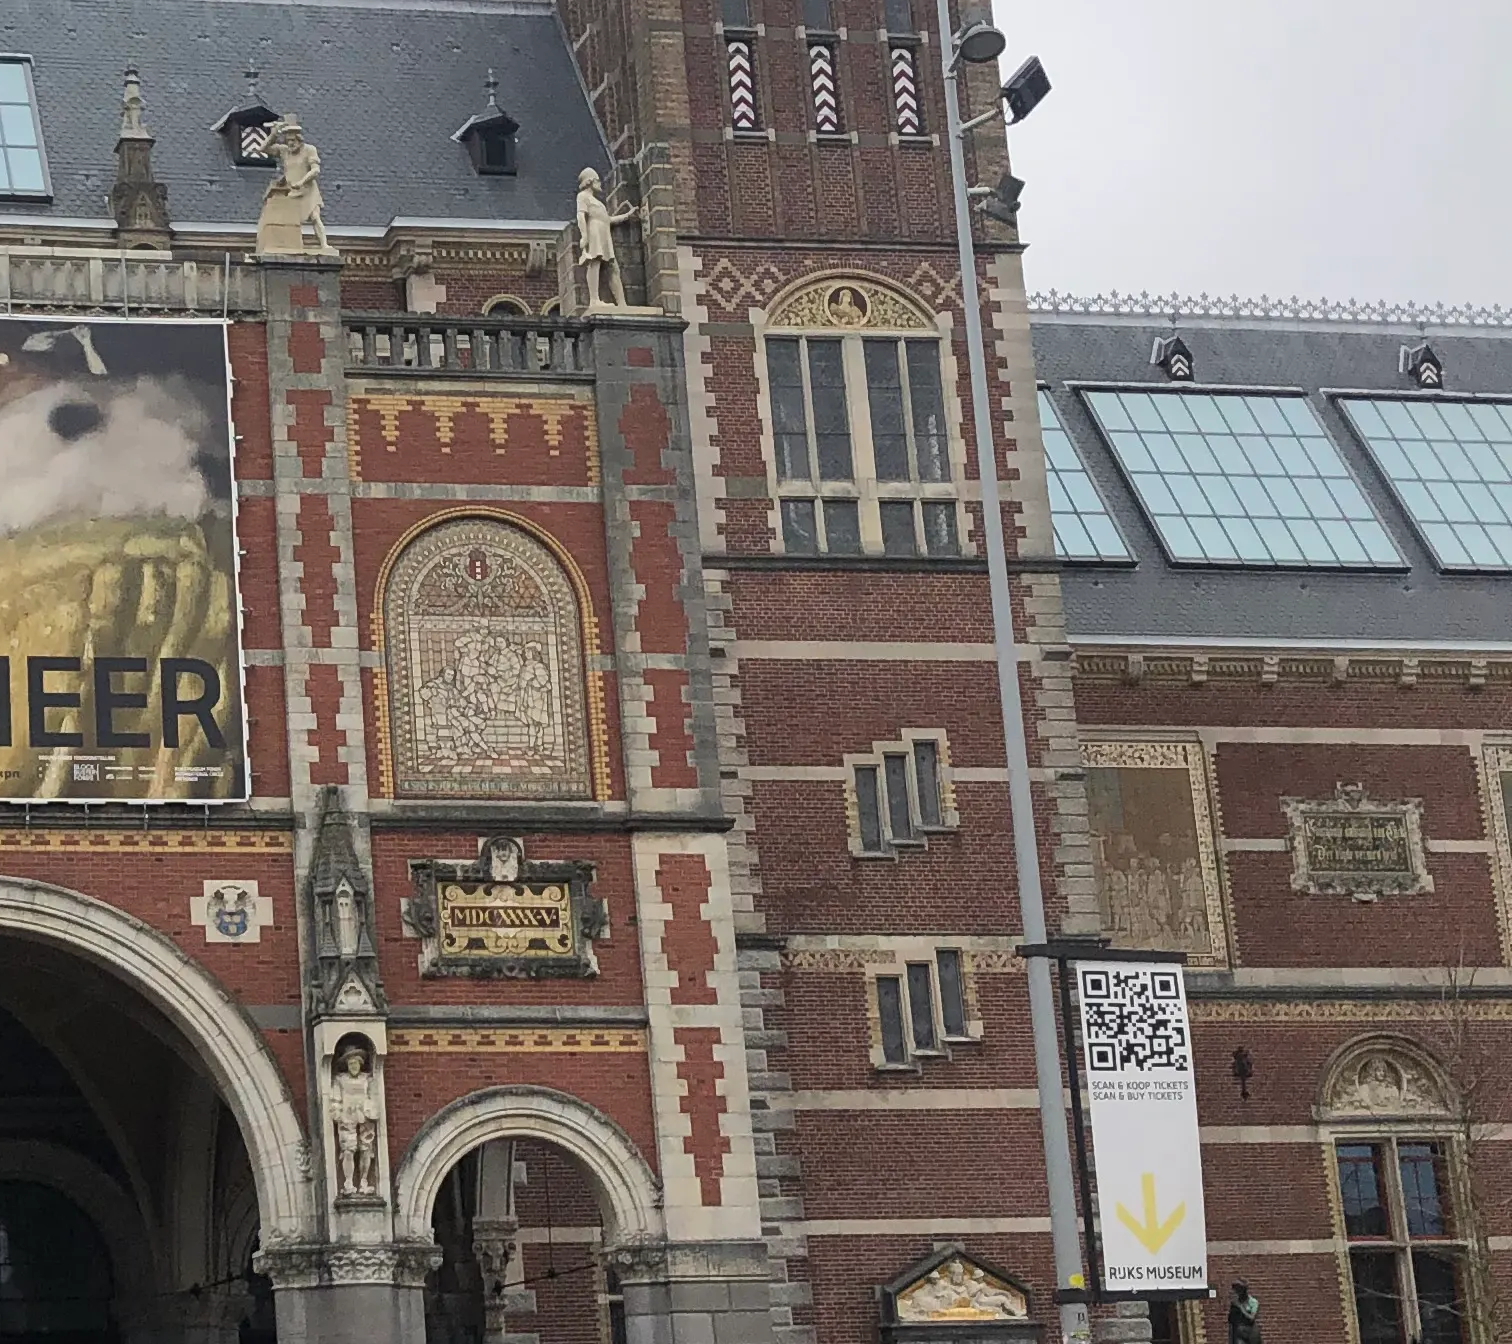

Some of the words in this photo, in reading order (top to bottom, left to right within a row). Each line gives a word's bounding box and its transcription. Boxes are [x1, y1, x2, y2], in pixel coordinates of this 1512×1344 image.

[1092, 1081, 1115, 1090] SCAN
[1125, 1081, 1150, 1090] KOOP
[1154, 1081, 1189, 1090] TICKETS
[1093, 1092, 1116, 1100] SCAN
[1127, 1092, 1145, 1101] BUY
[1148, 1092, 1183, 1101] TICKETS
[1110, 1267, 1143, 1280] RIJKS
[1146, 1266, 1203, 1280] MUSEUM
